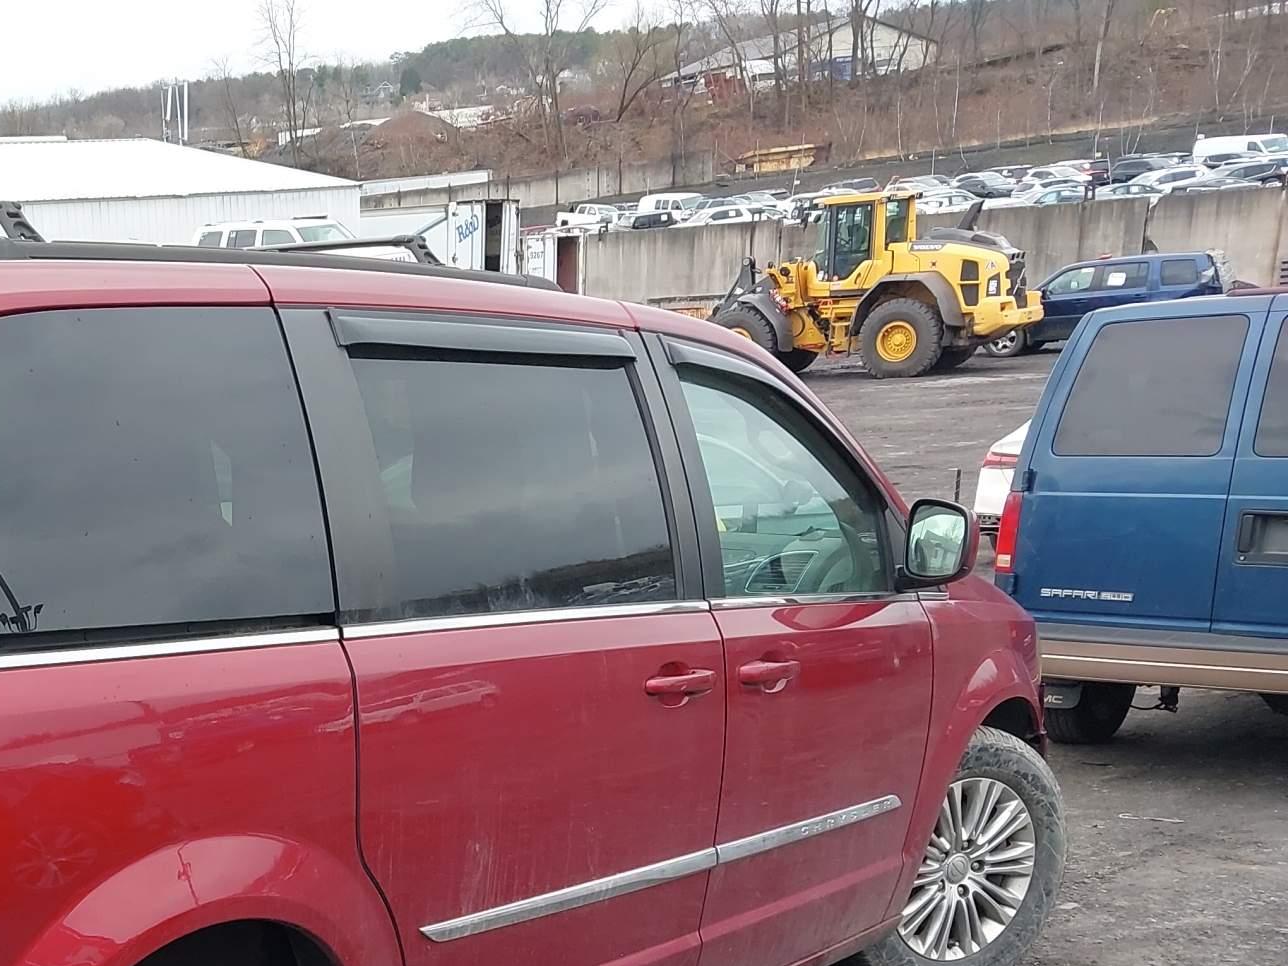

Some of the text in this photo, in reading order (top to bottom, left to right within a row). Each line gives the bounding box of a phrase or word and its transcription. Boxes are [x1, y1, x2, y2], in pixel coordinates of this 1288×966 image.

[1040, 587, 1099, 600] SAFARI
[1043, 694, 1064, 704] MC
[800, 799, 893, 837] CHRYSLER
